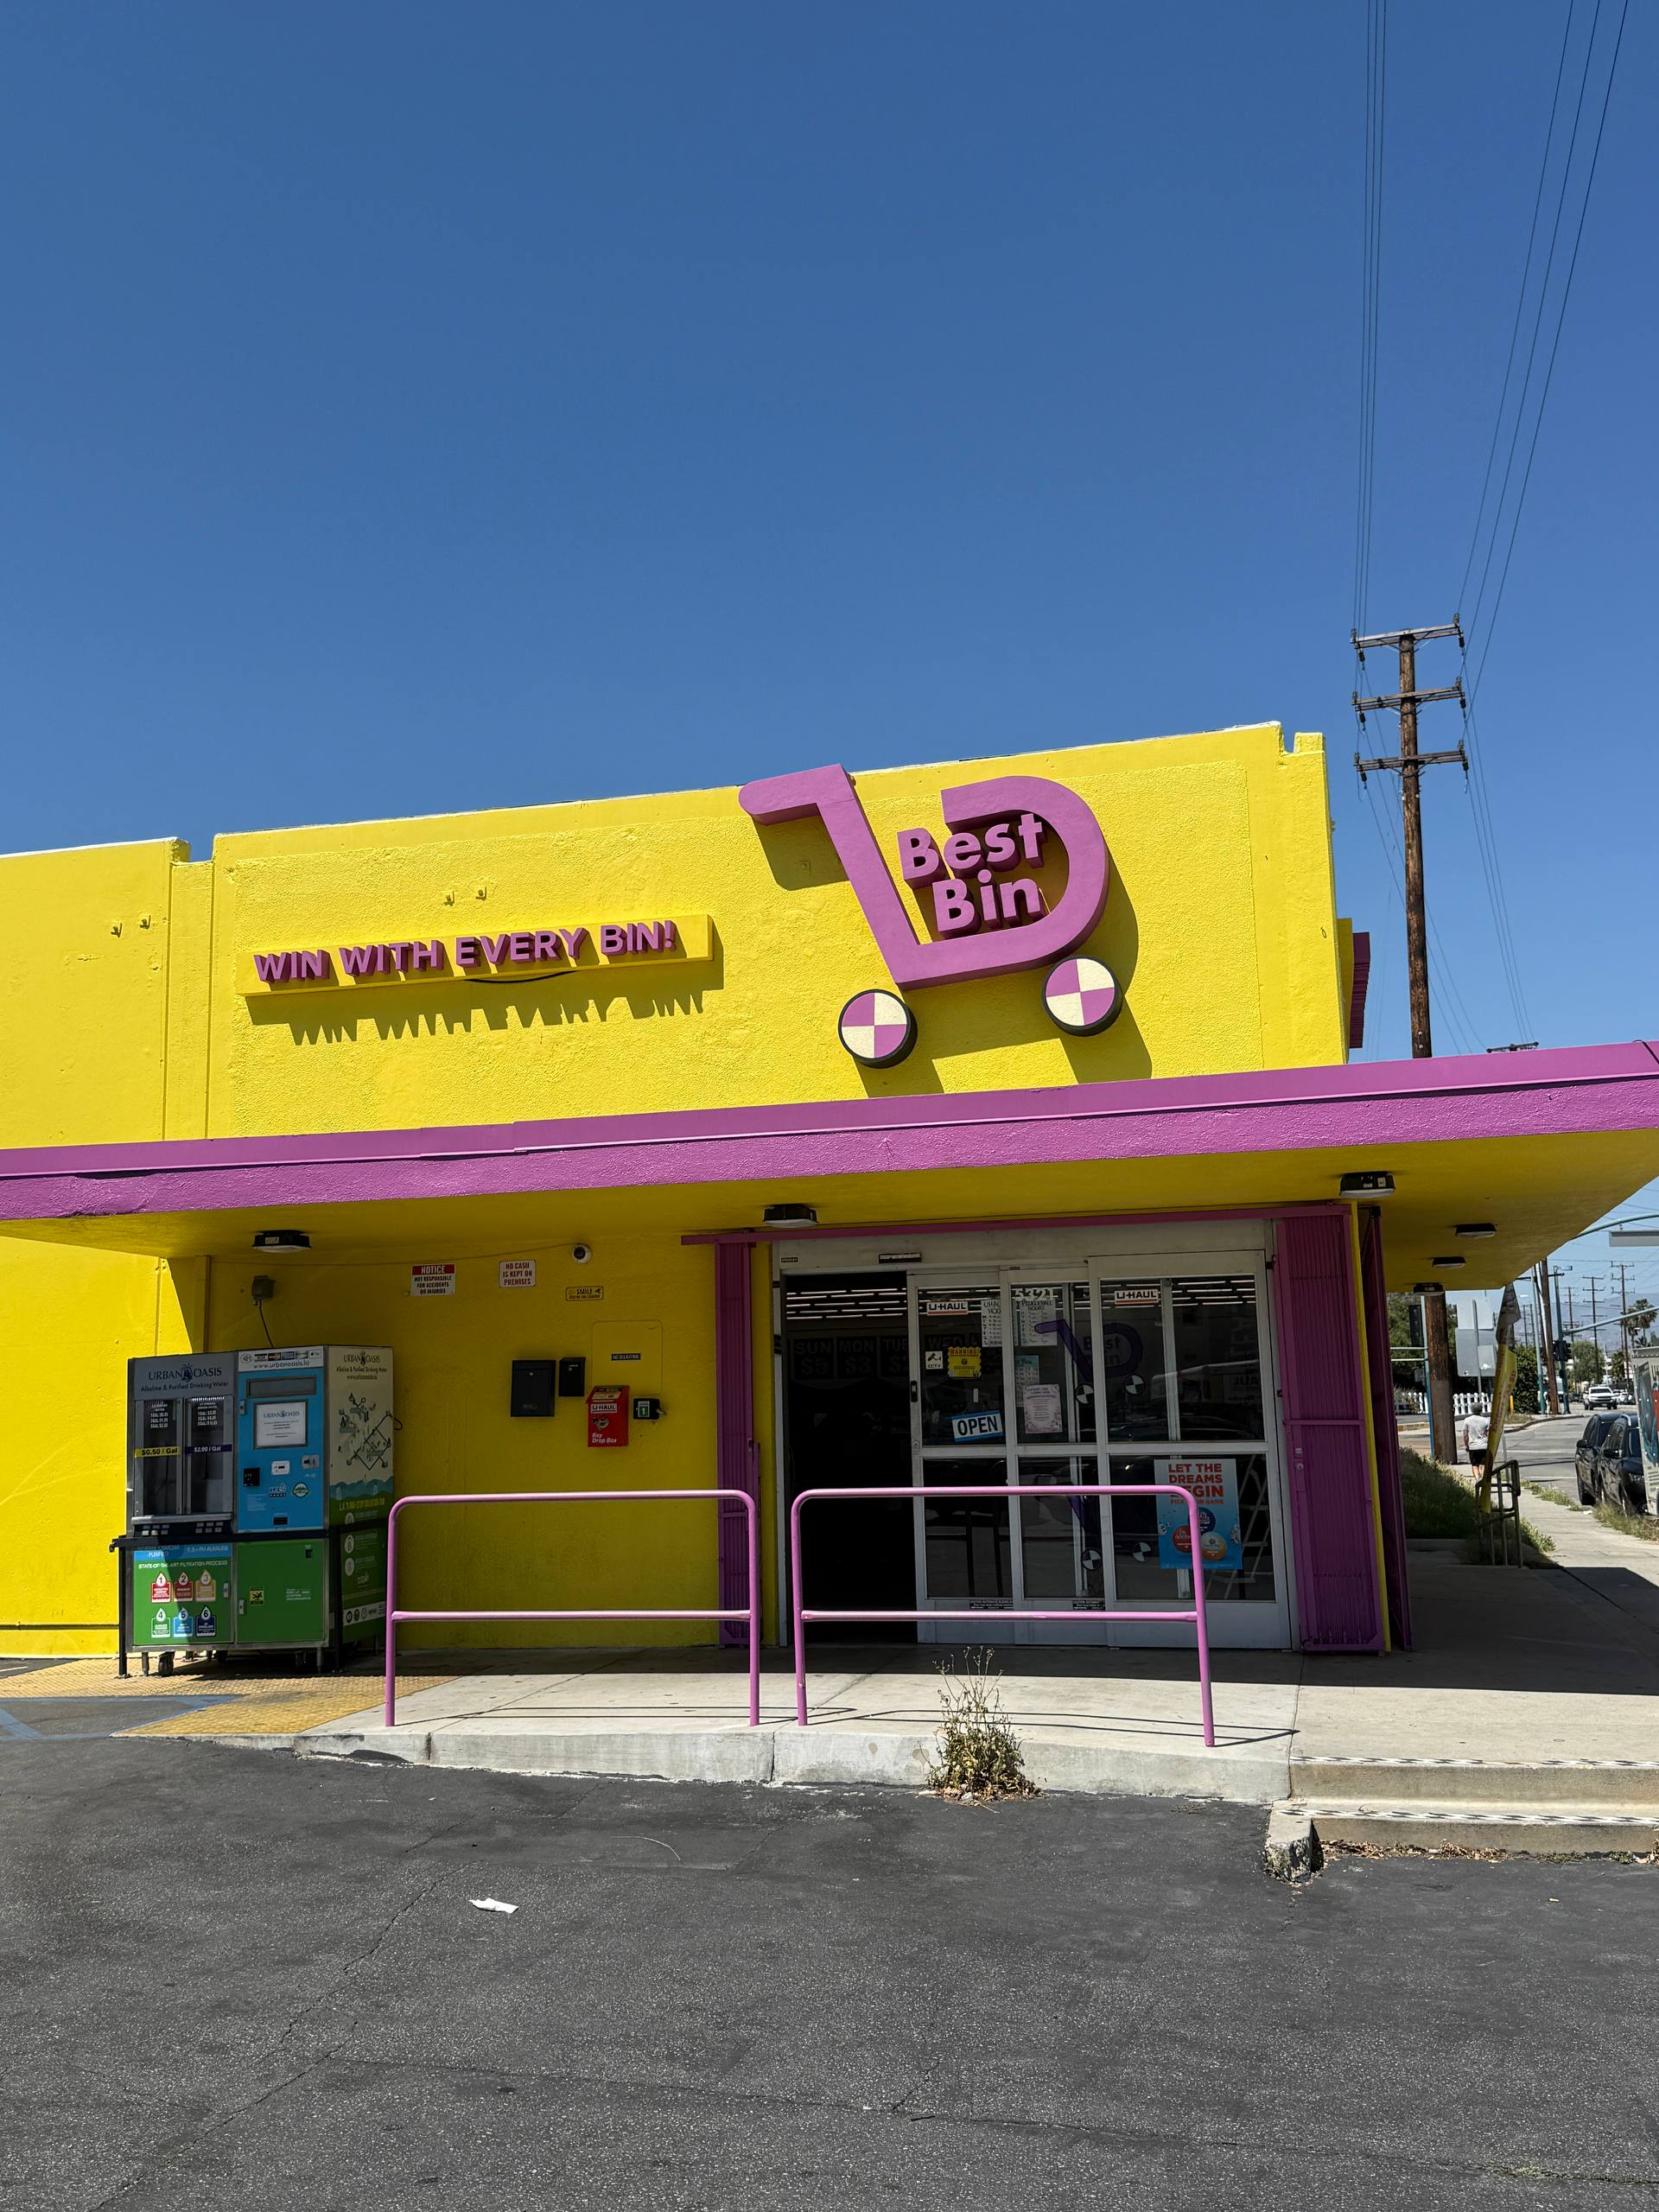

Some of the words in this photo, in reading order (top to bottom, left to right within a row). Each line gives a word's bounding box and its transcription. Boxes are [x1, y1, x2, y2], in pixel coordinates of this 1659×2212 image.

[897, 813, 1045, 887] Best
[932, 869, 1044, 936] Bin
[253, 950, 330, 982] WIN
[339, 939, 445, 976] WITH
[456, 927, 590, 967] EVERY
[600, 919, 677, 955] BIN!
[421, 1265, 446, 1274] NOTICE
[928, 1302, 967, 1311] U-HAUL
[795, 1341, 831, 1354] SUN
[839, 1339, 874, 1353] MON
[149, 1370, 182, 1381] URBAN
[193, 1367, 222, 1377] OASIS
[957, 1415, 998, 1436] OPEN
[1167, 1464, 1192, 1473] LET
[1195, 1463, 1222, 1472] THE
[1168, 1474, 1224, 1484] DREAMS
[181, 1574, 187, 1583] 2
[203, 1573, 209, 1582] 3
